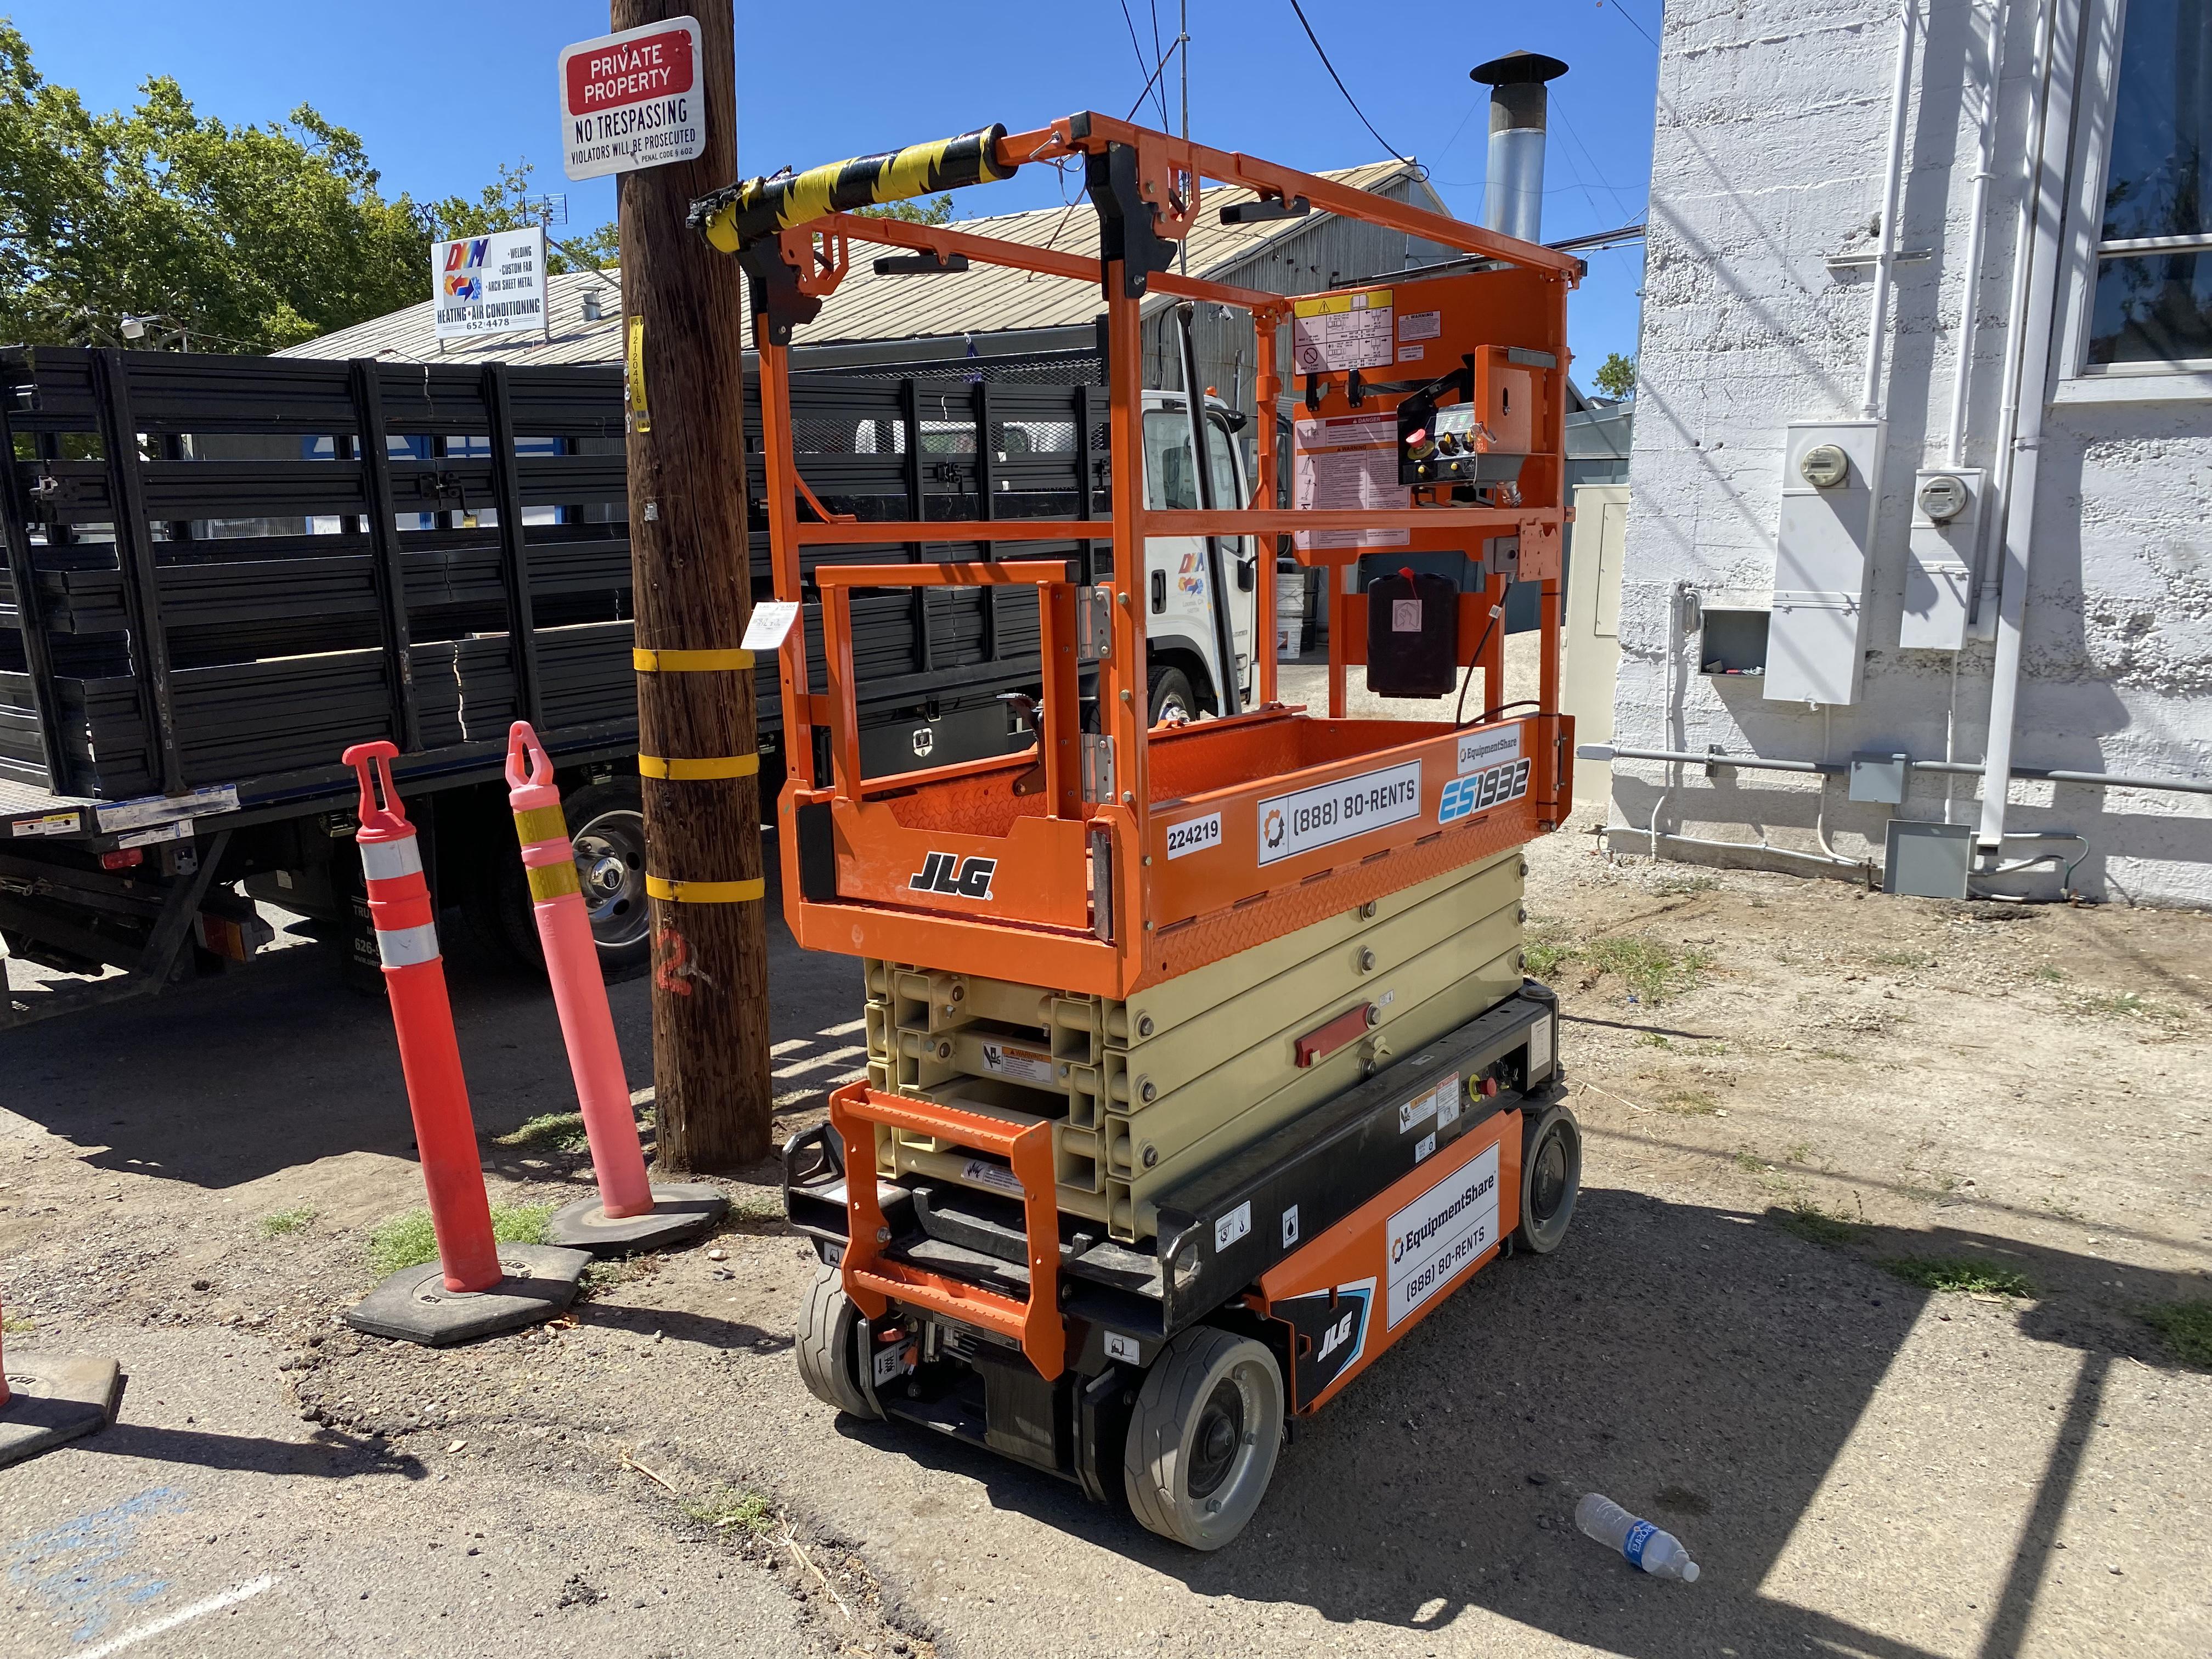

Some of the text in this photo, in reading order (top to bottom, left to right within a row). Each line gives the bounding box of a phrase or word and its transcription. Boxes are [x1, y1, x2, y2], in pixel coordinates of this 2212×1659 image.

[591, 44, 663, 79] PRIVATE
[585, 66, 671, 104] PROPERTY
[575, 98, 687, 144] NO TRESPASSING
[571, 128, 695, 165] VIOLATORS WILL BE PROSECUTED
[641, 154, 658, 163] PENAL
[659, 151, 674, 159] CODE
[680, 147, 693, 155] 602
[502, 261, 532, 275] CUSTOM FAB
[510, 246, 532, 259] WELDING
[488, 276, 533, 292] ARCH SHEET METAL
[437, 298, 540, 324] HEATING AIR CONDITIONING
[486, 318, 510, 327] 4478
[1358, 416, 1381, 425] DANGER
[1467, 738, 1517, 760] EquipmentShare
[1294, 779, 1415, 836] (888) 80-RENTS
[1439, 760, 1530, 822] ES1932
[1169, 820, 1218, 851] 224219
[909, 851, 997, 900] JLG
[353, 905, 373, 919] TRU
[1406, 1173, 1494, 1253] EquipmentShare
[1406, 1226, 1485, 1303] (888) 80-RENTS
[1317, 1310, 1353, 1363] JLG
